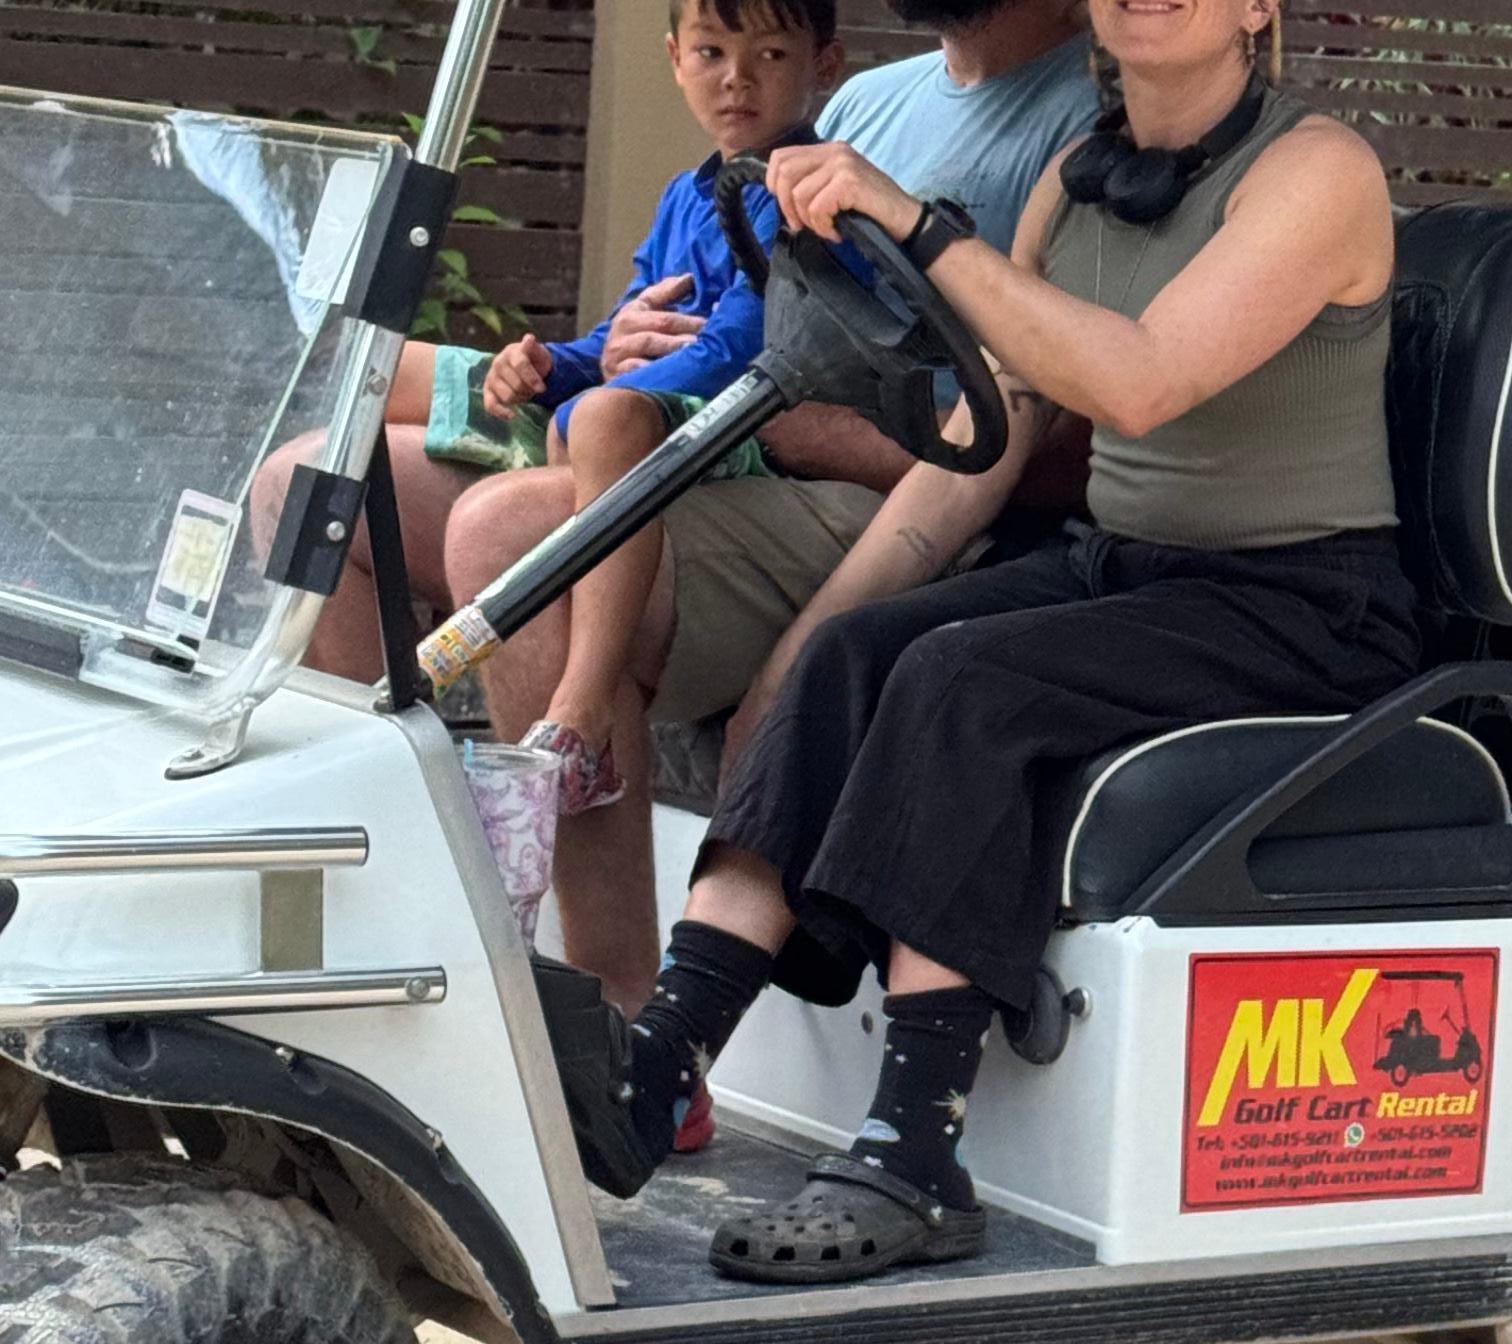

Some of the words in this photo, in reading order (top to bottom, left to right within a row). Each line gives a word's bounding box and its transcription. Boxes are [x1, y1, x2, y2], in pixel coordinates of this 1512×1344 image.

[1197, 968, 1380, 1126] MK
[1234, 1097, 1301, 1124] Golf
[1307, 1096, 1372, 1121] Cart
[1376, 1089, 1478, 1119] Rental
